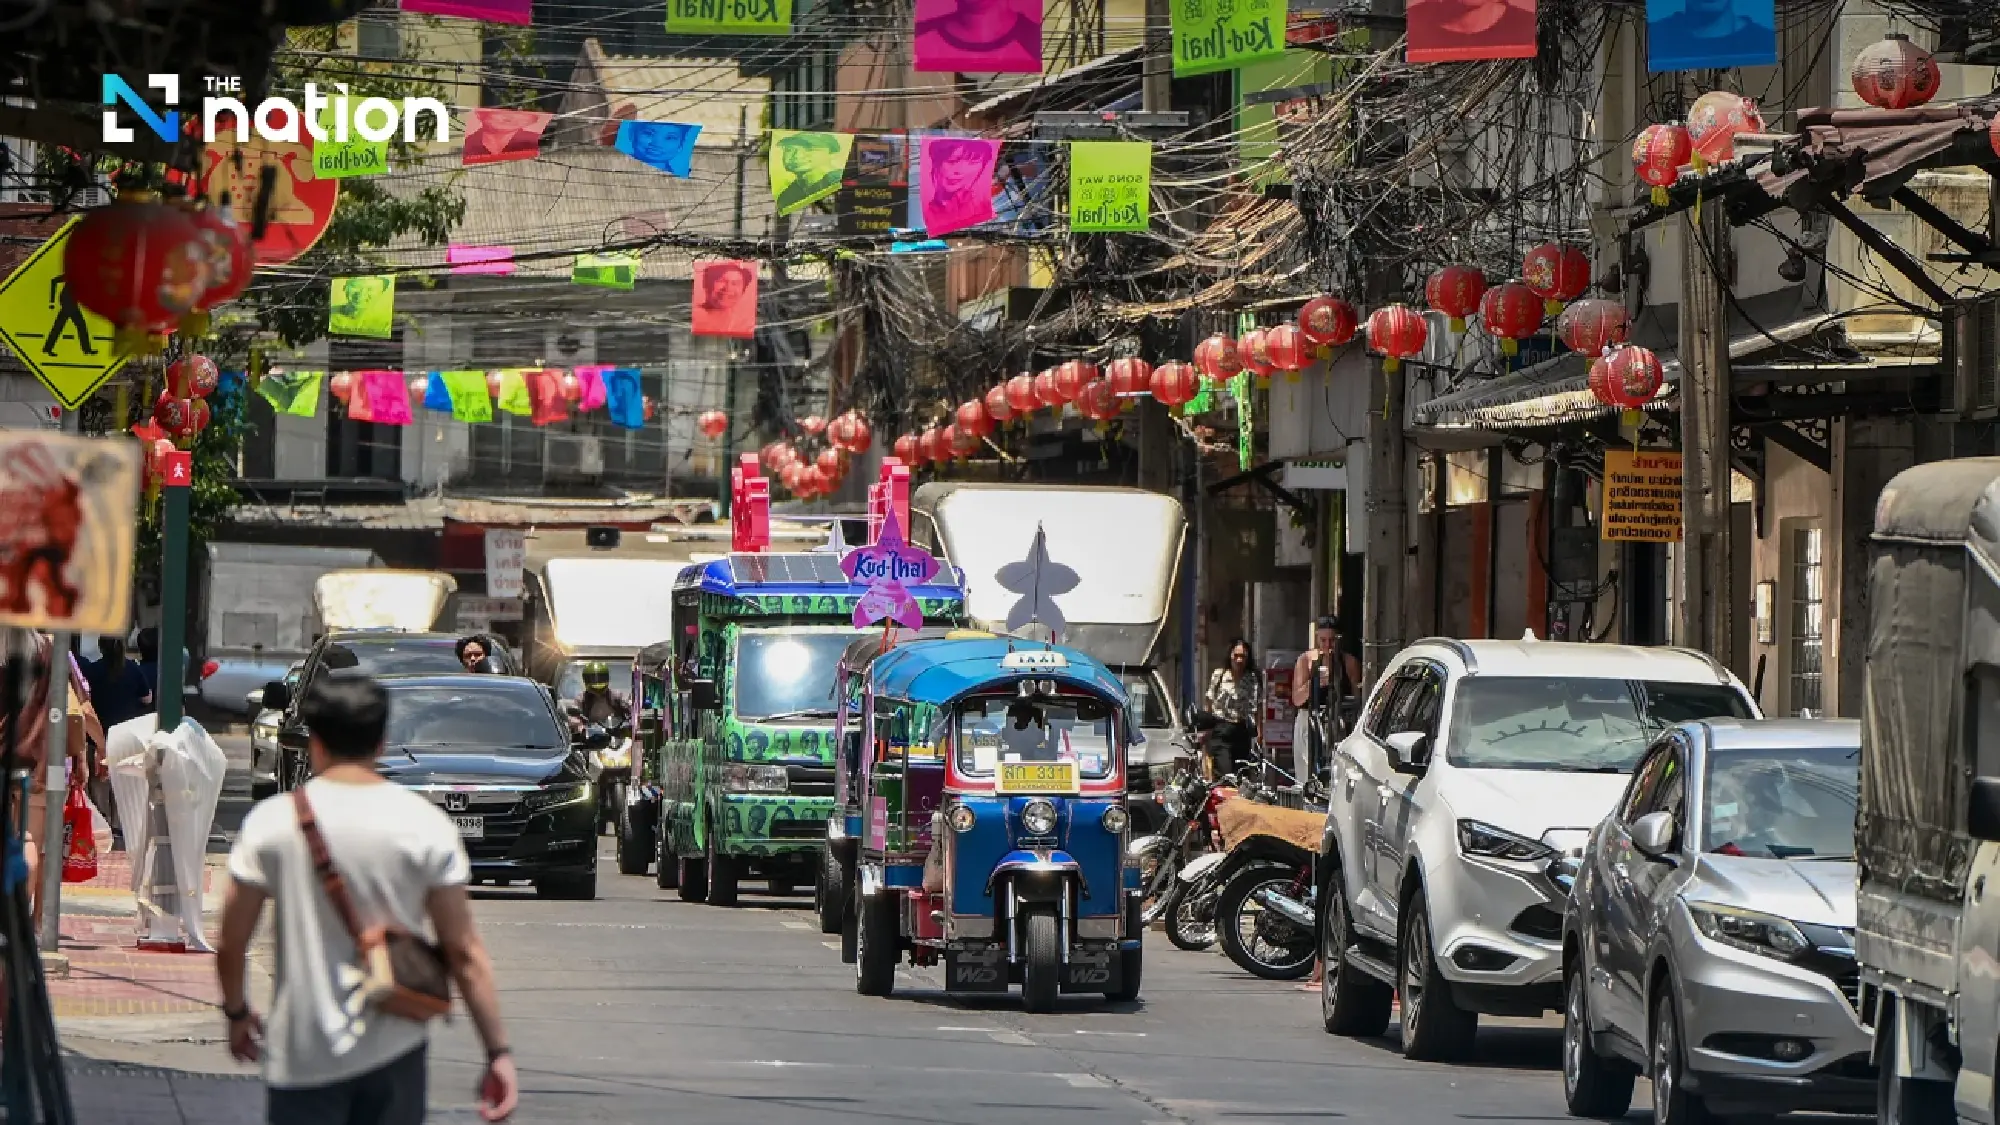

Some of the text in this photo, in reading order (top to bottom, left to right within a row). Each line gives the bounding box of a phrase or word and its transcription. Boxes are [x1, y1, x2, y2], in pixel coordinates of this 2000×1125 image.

[1018, 653, 1056, 664] TAXI
[1036, 765, 1065, 779] 331
[956, 966, 998, 983] WD
[1070, 966, 1110, 984] WD
